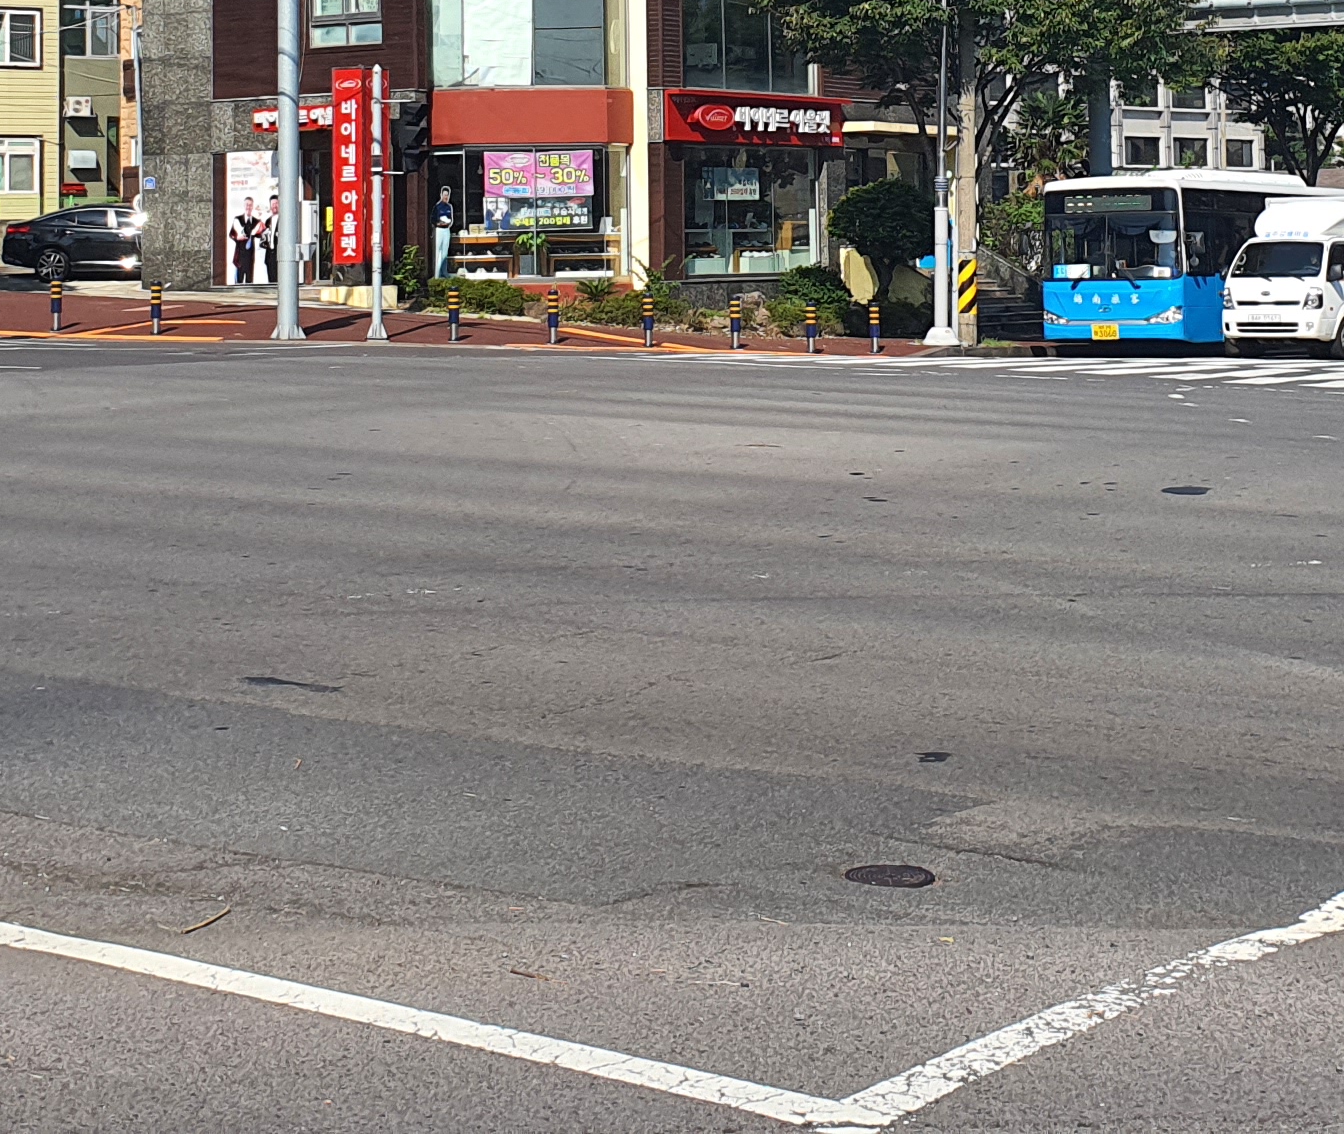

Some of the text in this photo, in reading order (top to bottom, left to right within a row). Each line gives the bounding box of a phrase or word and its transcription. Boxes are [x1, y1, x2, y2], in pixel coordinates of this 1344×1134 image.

[734, 106, 830, 133] 바이네르 아울렛
[341, 99, 357, 257] 바이네르 아울렛
[489, 169, 527, 185] 50%
[551, 168, 590, 183] 30%
